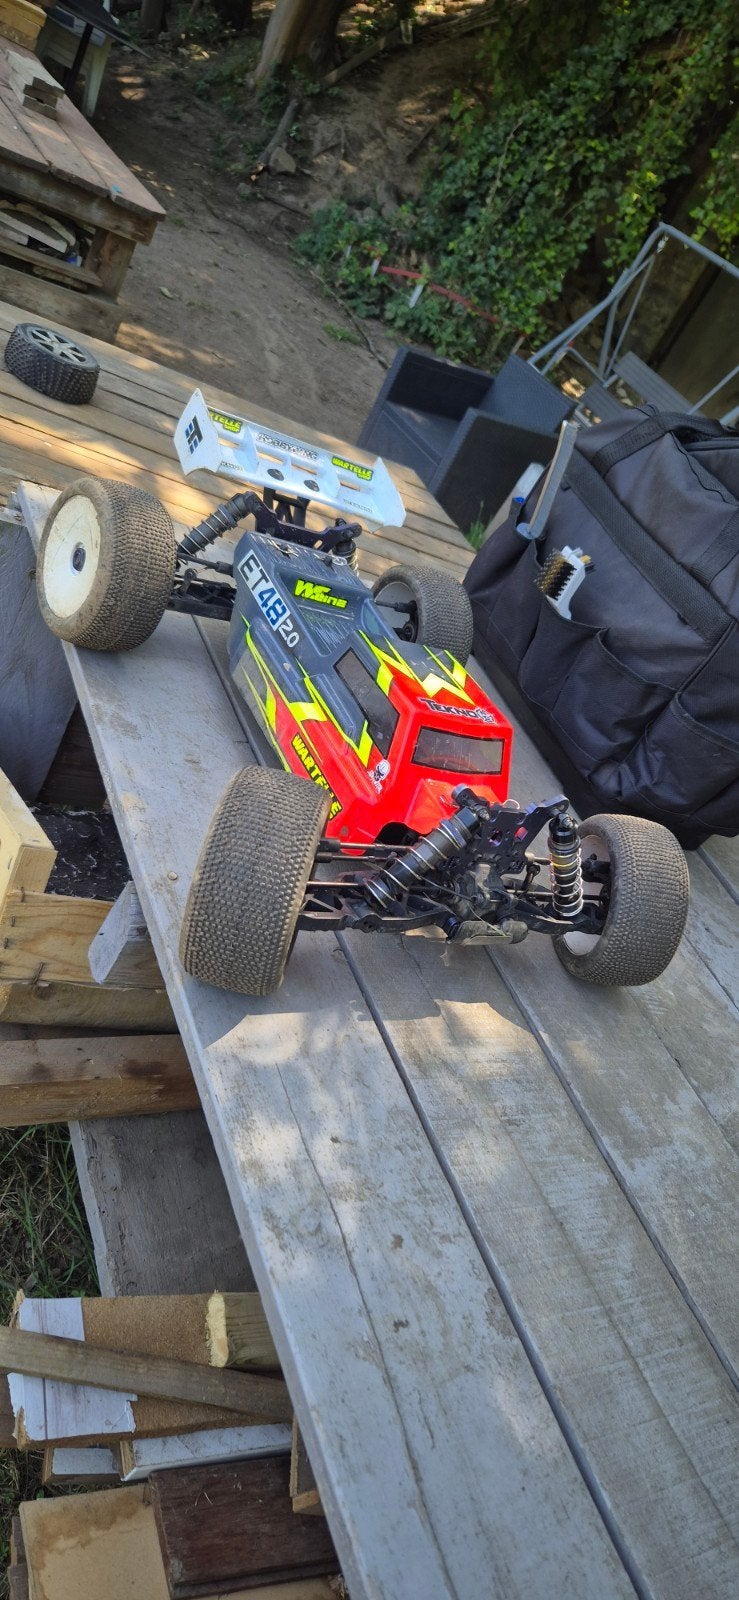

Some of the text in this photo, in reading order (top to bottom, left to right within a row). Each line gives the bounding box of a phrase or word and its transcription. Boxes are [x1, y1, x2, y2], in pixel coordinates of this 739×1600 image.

[332, 457, 373, 477] WARTELLE
[239, 553, 288, 627] ET48
[292, 733, 342, 817] WARTEE
